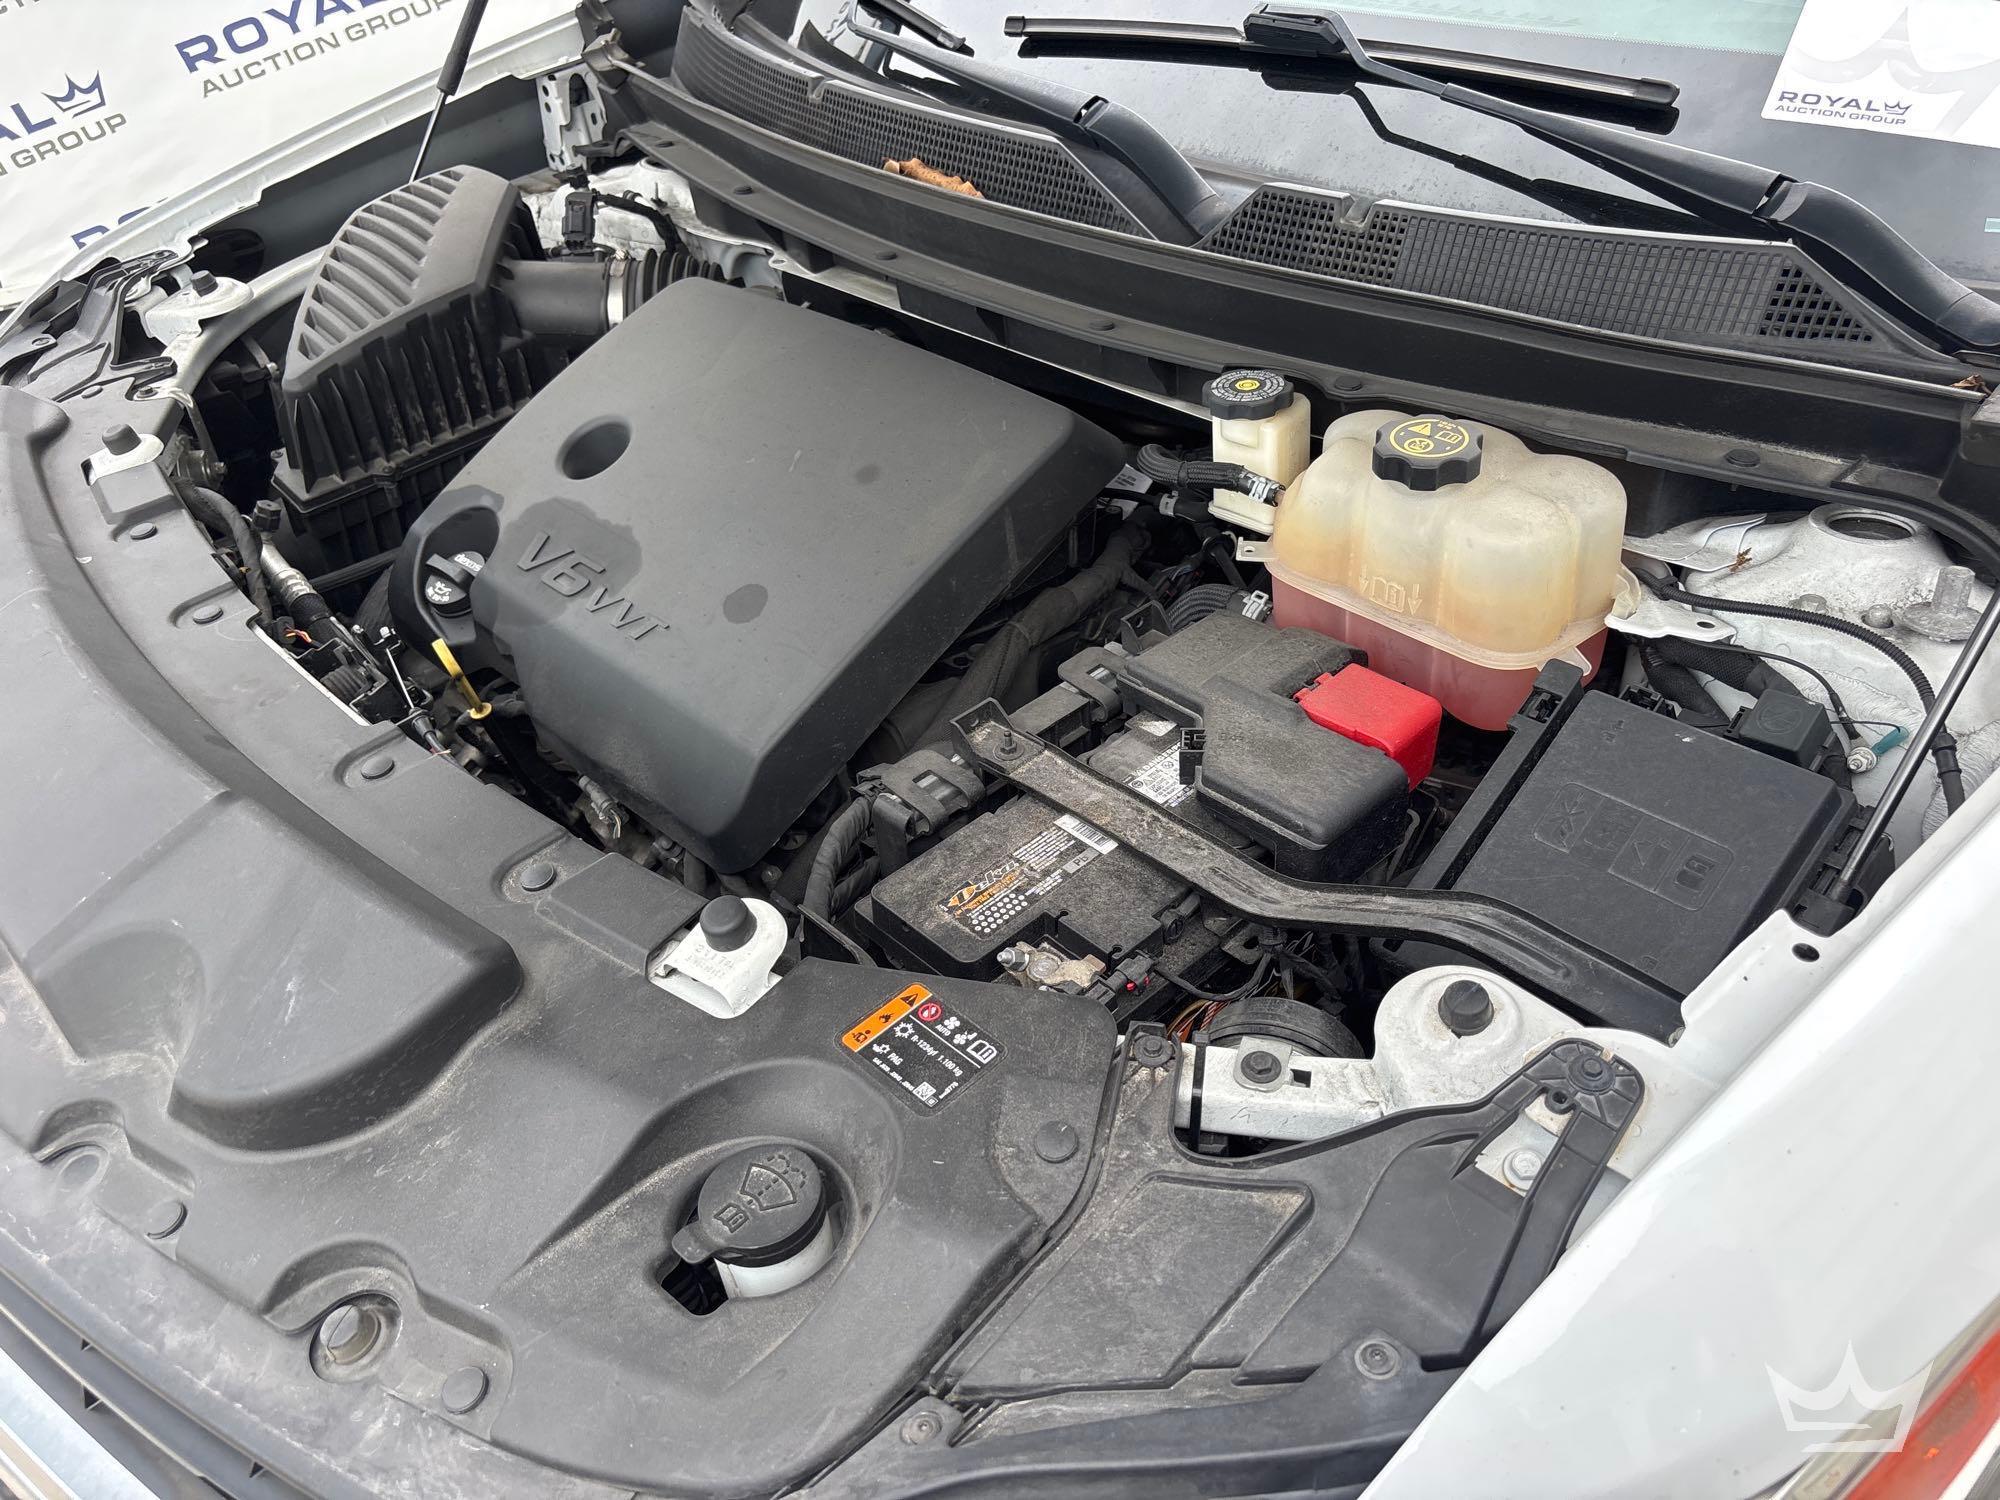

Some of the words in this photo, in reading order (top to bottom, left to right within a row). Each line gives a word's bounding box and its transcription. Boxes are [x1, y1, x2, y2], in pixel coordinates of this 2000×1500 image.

[175, 0, 395, 73] ROYA
[202, 32, 341, 98] AUCTION
[1778, 91, 1880, 112] ROYAL
[1774, 104, 1846, 118] AUCTION
[1849, 112, 1907, 125] GROUP
[10, 113, 127, 168] GROUP
[454, 553, 483, 572] dexos
[517, 531, 606, 597] V6
[585, 587, 670, 640] VVT
[935, 1024, 951, 1036] AUTO
[887, 1052, 903, 1066] PAG
[937, 1055, 956, 1070] 1.100
[952, 1066, 963, 1077] kg
